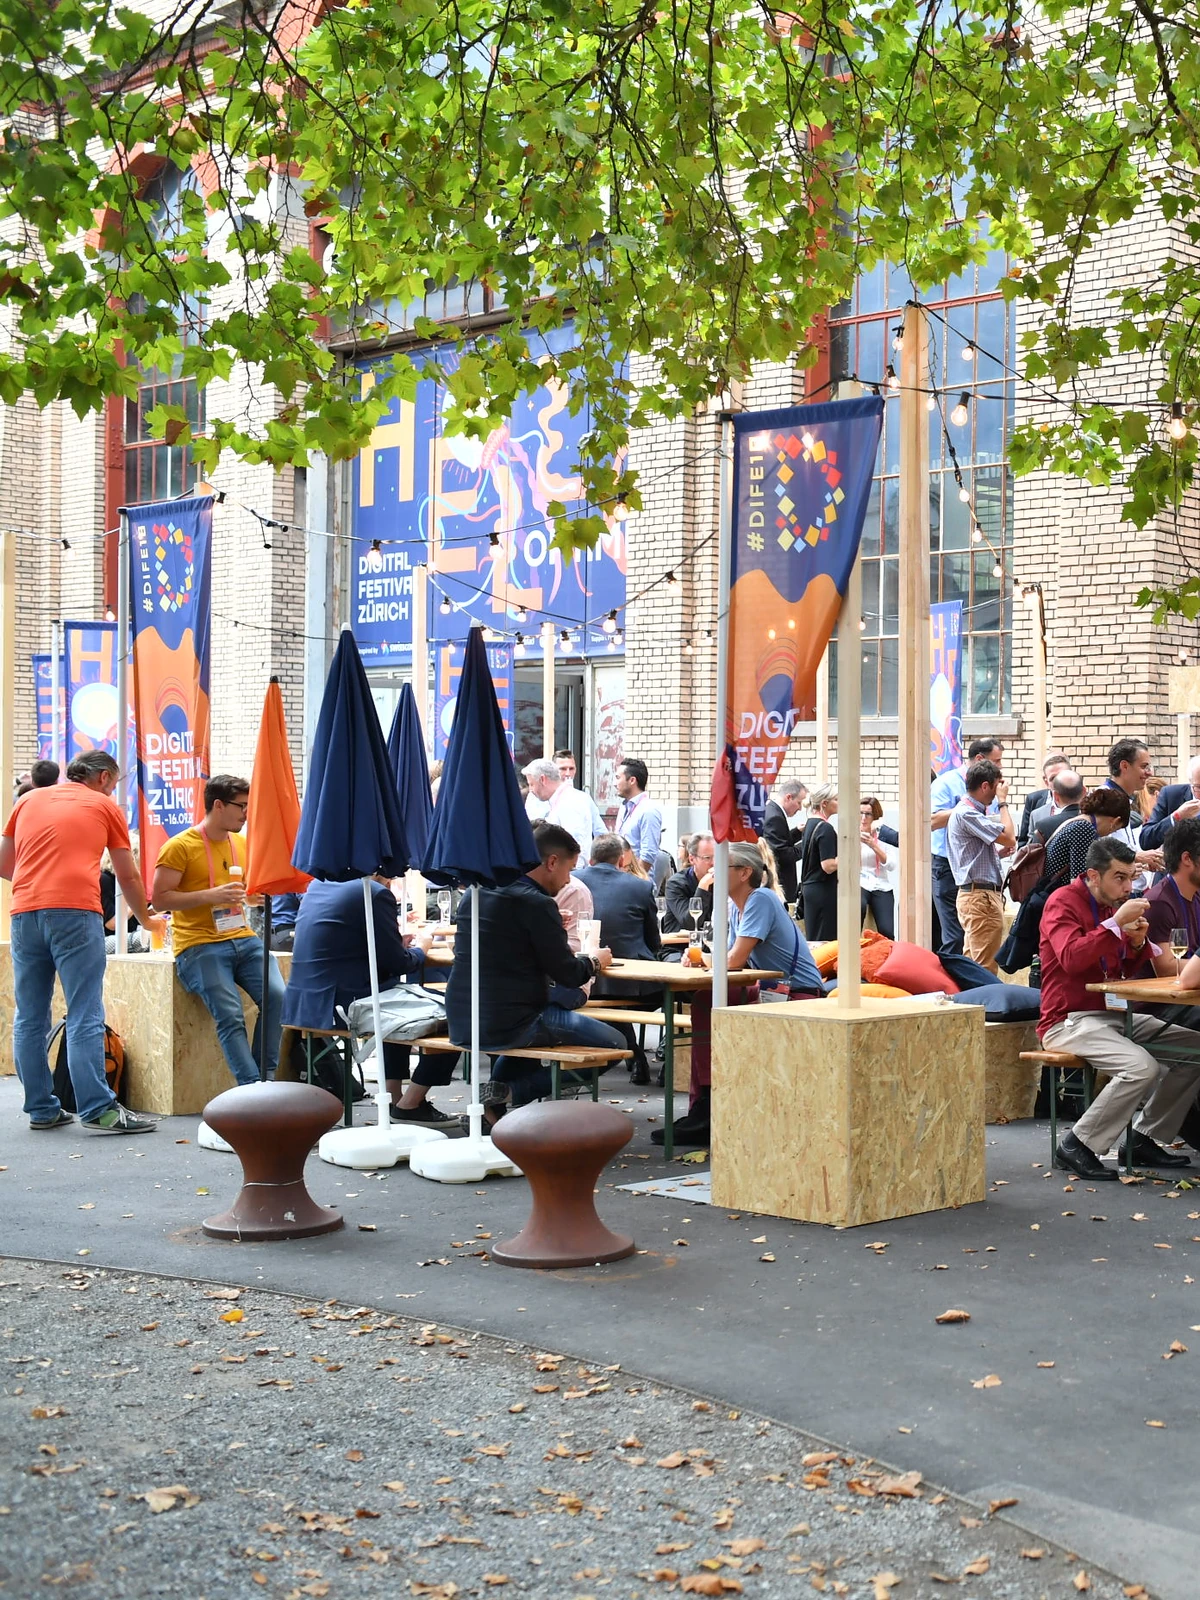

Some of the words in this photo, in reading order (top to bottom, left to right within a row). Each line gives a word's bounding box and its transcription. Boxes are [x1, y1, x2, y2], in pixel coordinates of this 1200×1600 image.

[358, 575, 413, 599] FESTIVA
[357, 599, 409, 624] ZÜRICH
[147, 782, 194, 811] ZÜRIC
